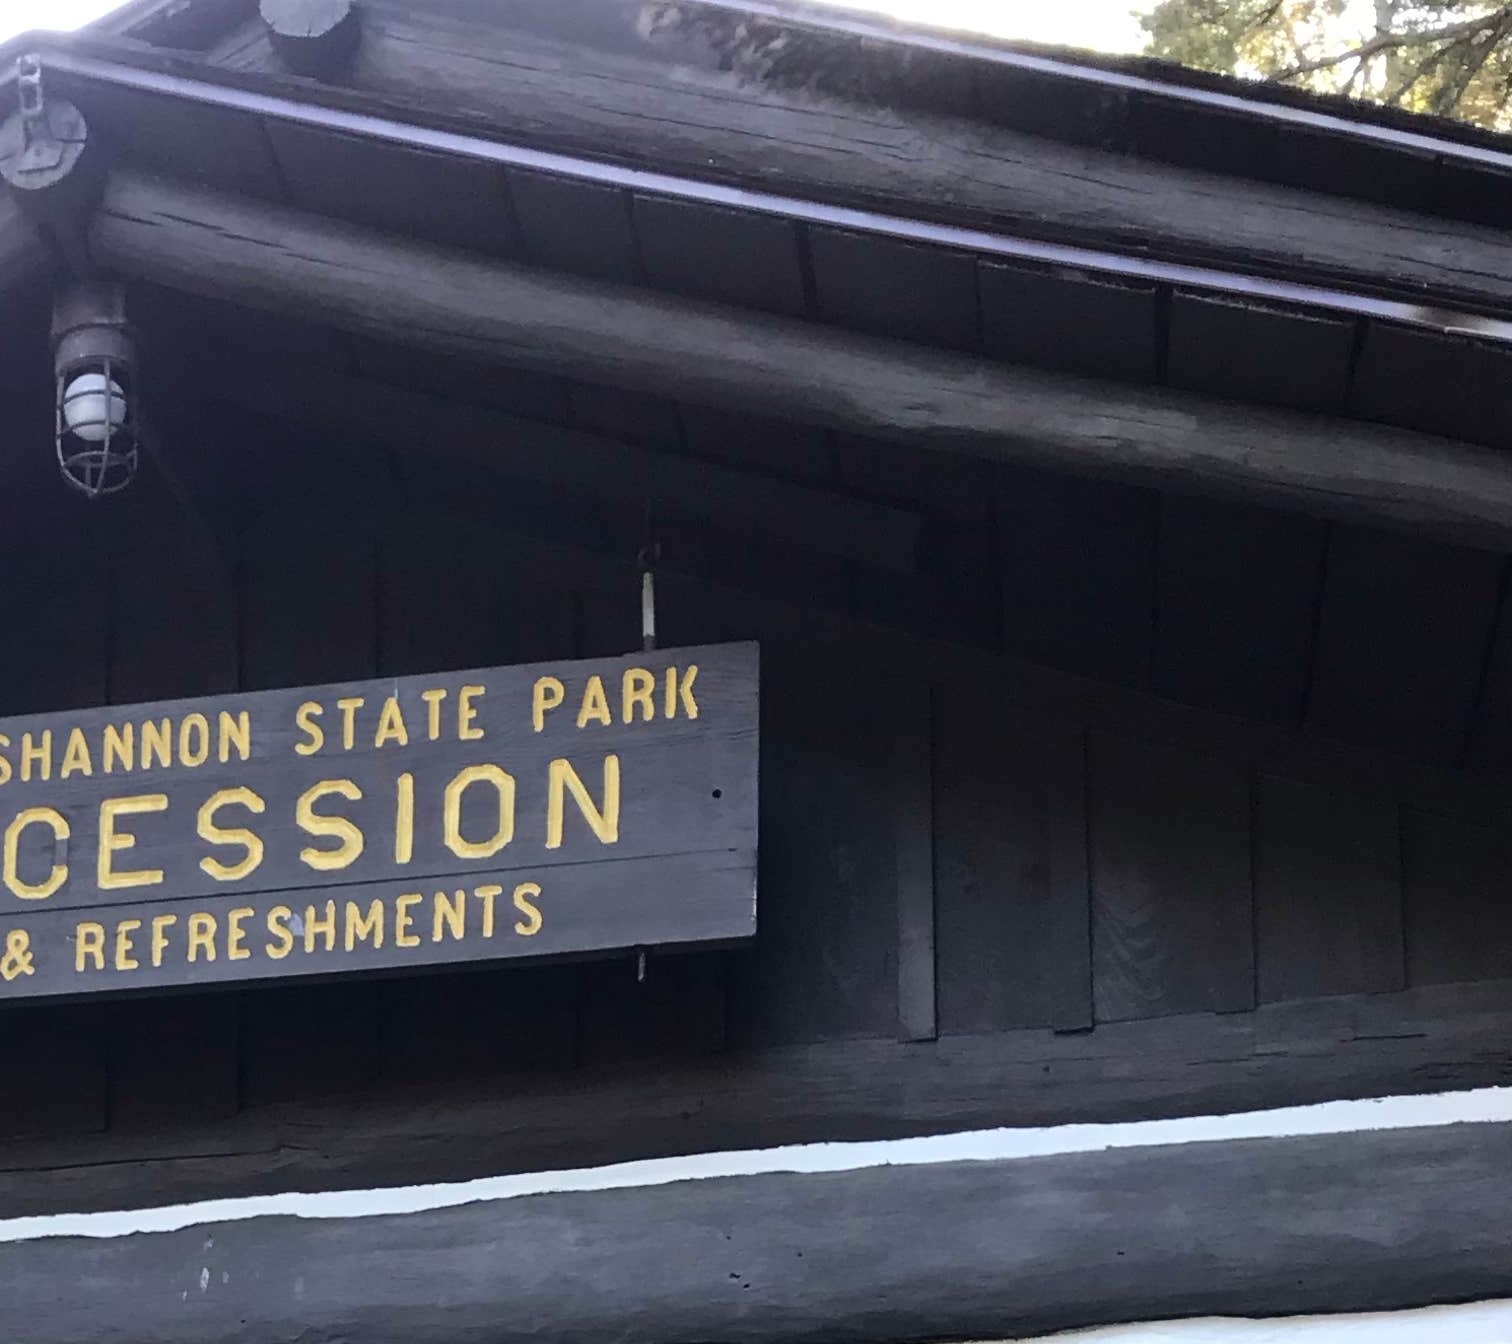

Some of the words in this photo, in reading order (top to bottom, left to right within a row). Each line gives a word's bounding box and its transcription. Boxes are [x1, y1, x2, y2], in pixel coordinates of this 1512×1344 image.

[295, 684, 485, 756] STATE
[532, 665, 699, 732] PARK
[0, 928, 34, 980] &
[75, 881, 543, 974] REFRESHMENTS
